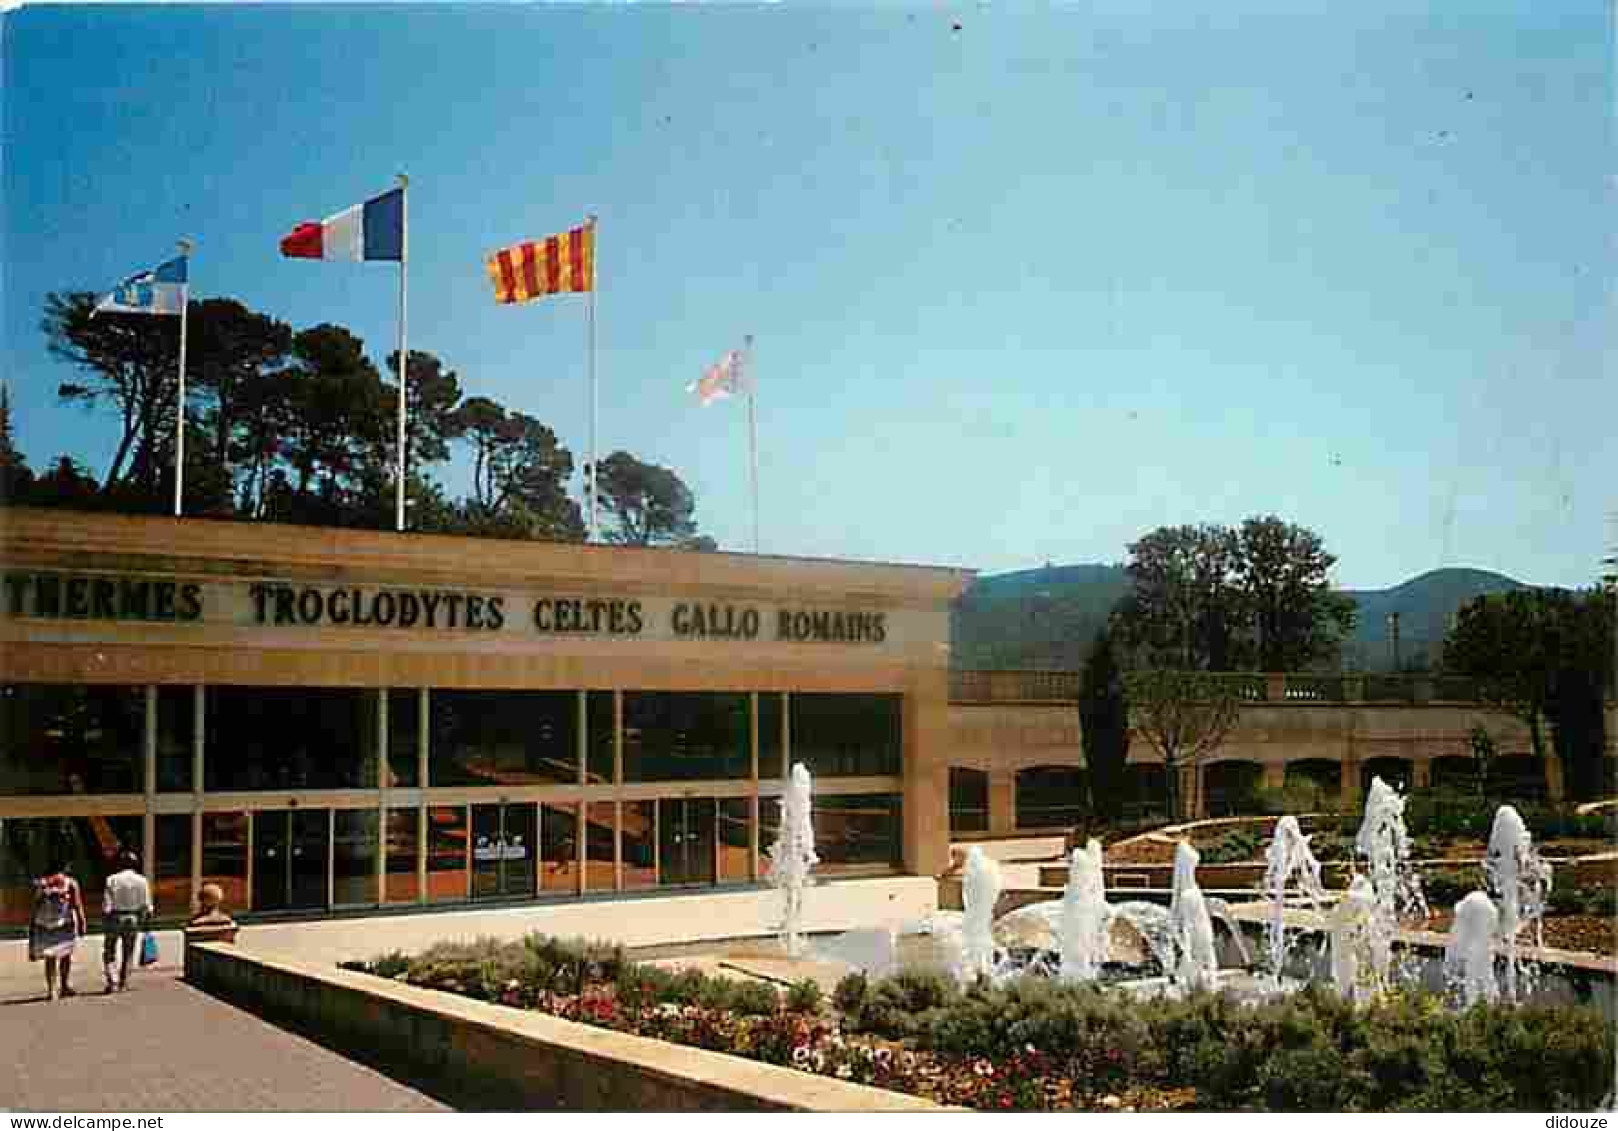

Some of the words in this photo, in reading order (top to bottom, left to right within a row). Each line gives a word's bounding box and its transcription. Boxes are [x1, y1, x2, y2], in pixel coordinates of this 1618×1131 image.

[5, 573, 203, 620] THERMES
[249, 582, 504, 630] TROGLODYTES
[533, 598, 643, 634] CELTES
[671, 604, 759, 640] GALLO
[777, 611, 887, 643] ROMAINS
